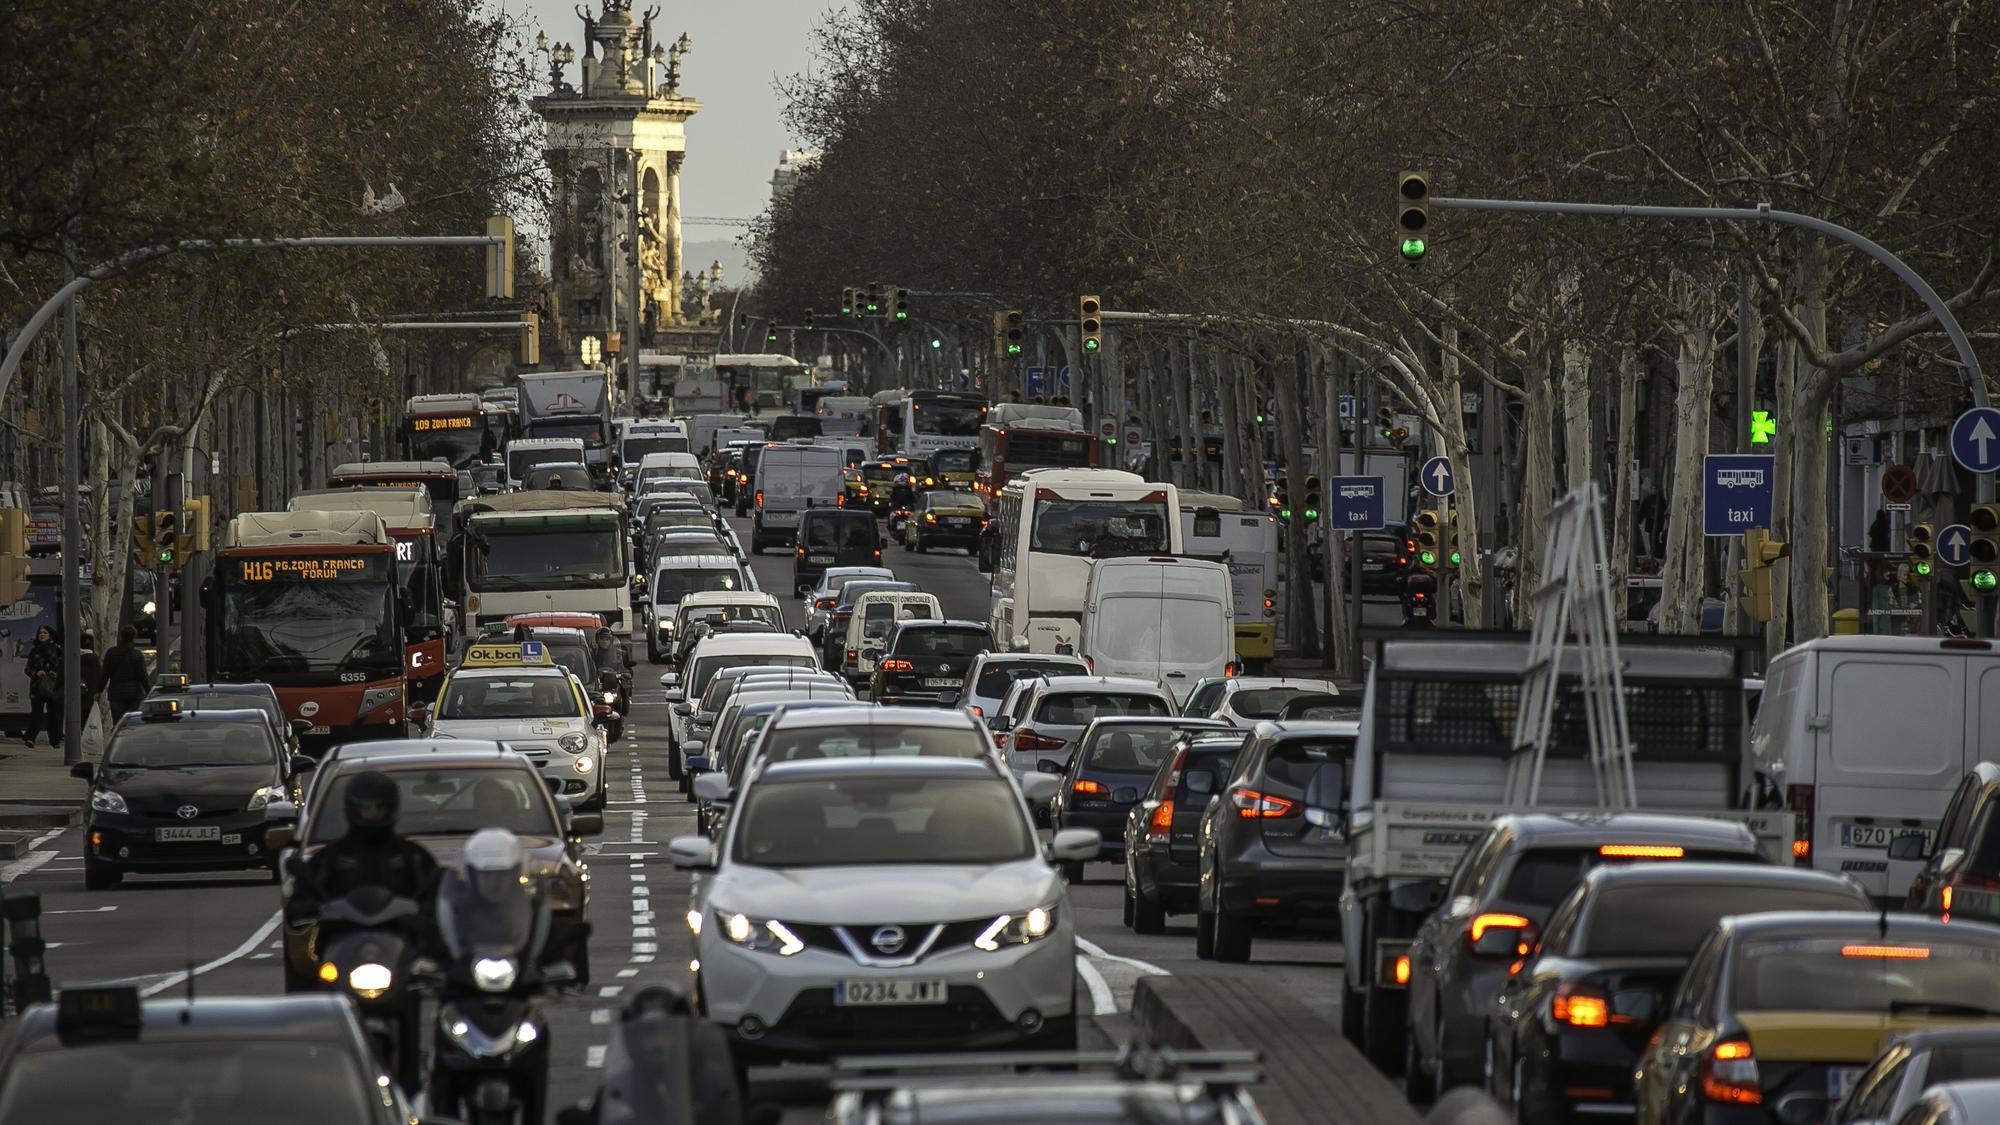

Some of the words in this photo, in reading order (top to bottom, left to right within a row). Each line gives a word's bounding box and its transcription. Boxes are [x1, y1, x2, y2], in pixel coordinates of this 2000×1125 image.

[415, 420, 430, 430] 109
[432, 419, 447, 429] ZONA
[448, 417, 471, 428] FRANCA
[1349, 510, 1368, 521] taxi
[1728, 507, 1753, 522] taxi
[275, 560, 319, 571] PG.ZONA
[323, 559, 365, 569] FRANCA
[243, 562, 273, 580] H16
[302, 569, 337, 579] FORUM
[471, 650, 521, 659] Ok.bcn
[527, 644, 538, 655] L
[340, 672, 366, 682] 6355
[163, 829, 193, 839] 3444
[197, 828, 218, 838] JLF
[224, 836, 240, 844] SP
[848, 982, 898, 1001] 0234
[905, 982, 941, 1001] JVT
